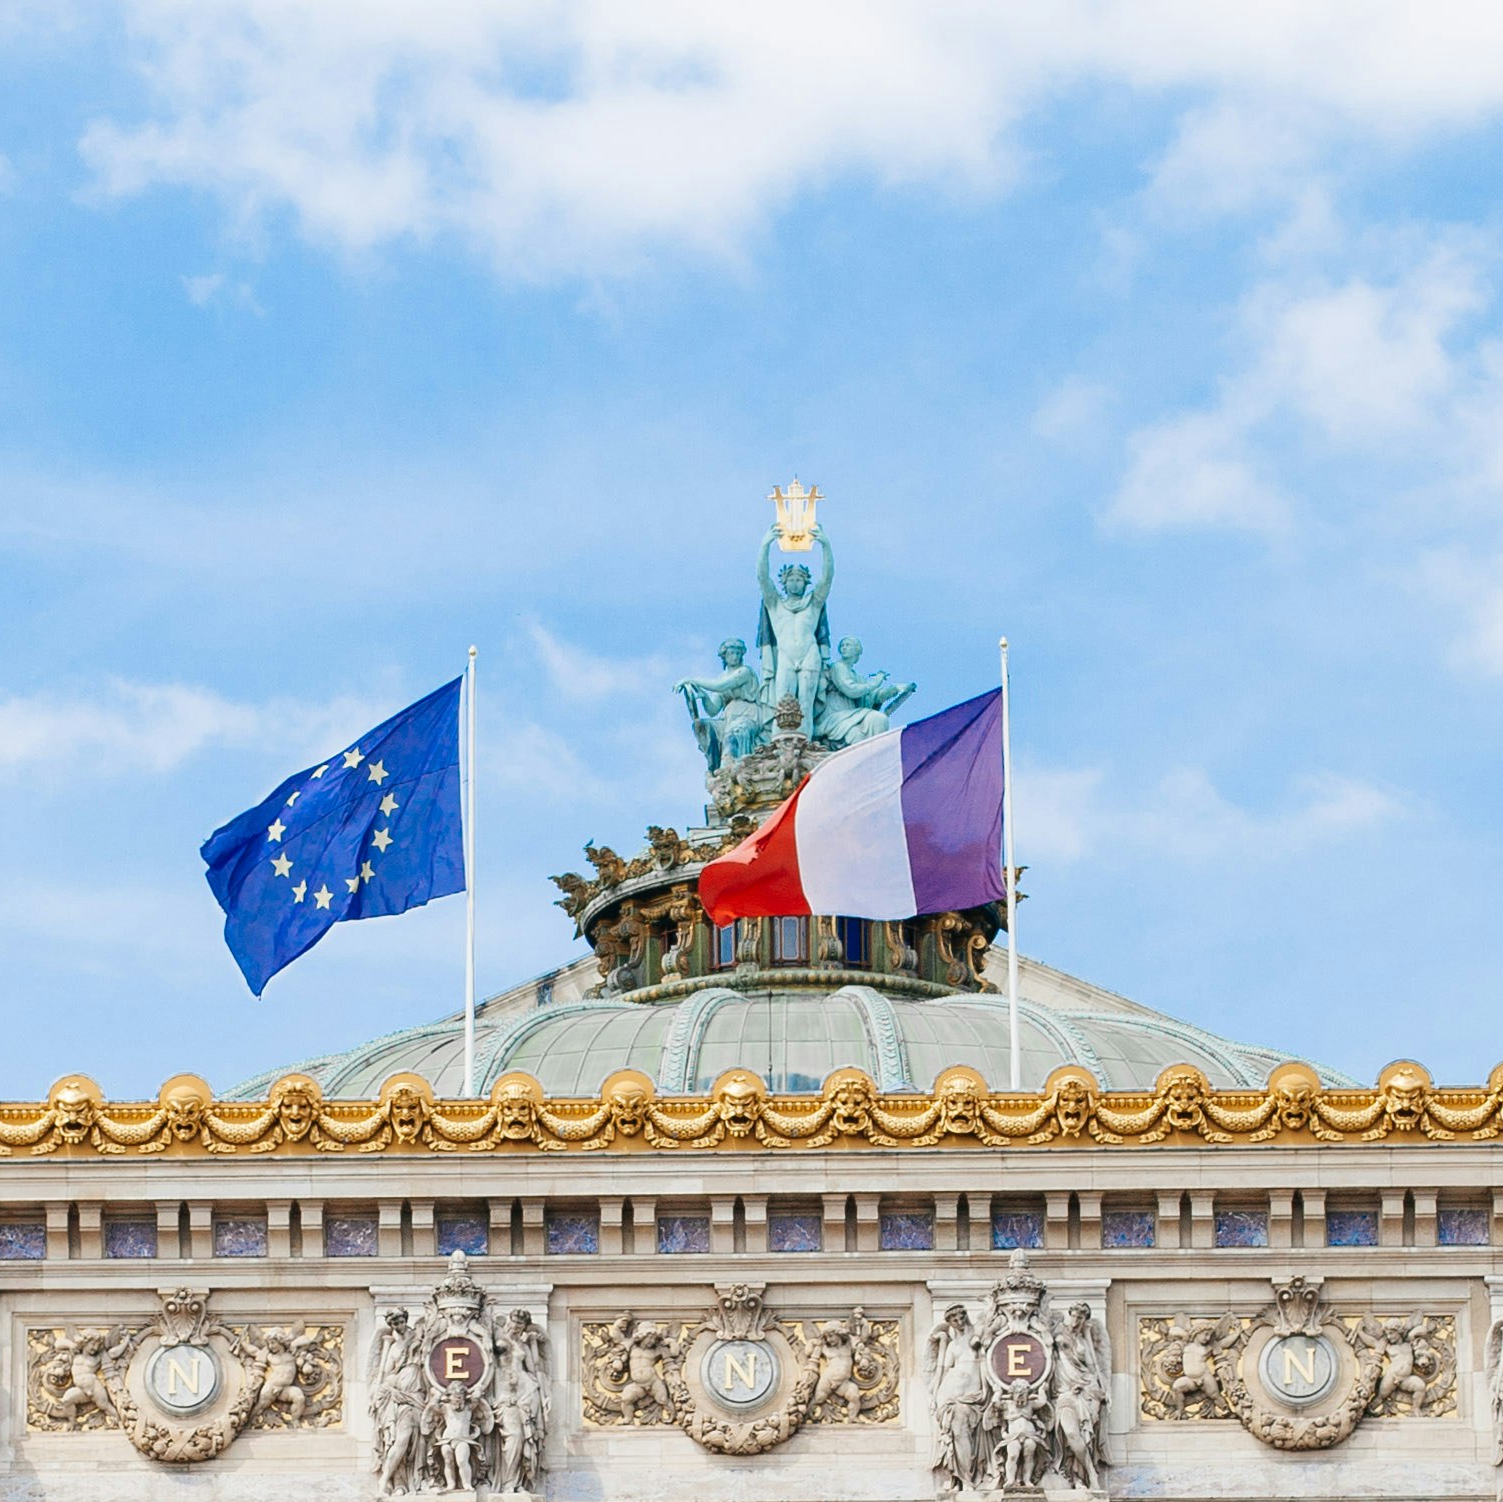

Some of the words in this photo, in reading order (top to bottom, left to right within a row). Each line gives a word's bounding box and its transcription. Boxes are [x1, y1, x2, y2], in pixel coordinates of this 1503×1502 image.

[167, 1357, 200, 1395] N
[445, 1346, 470, 1380] E
[723, 1353, 757, 1391] N
[1006, 1343, 1032, 1377] E
[1282, 1347, 1315, 1385] N
